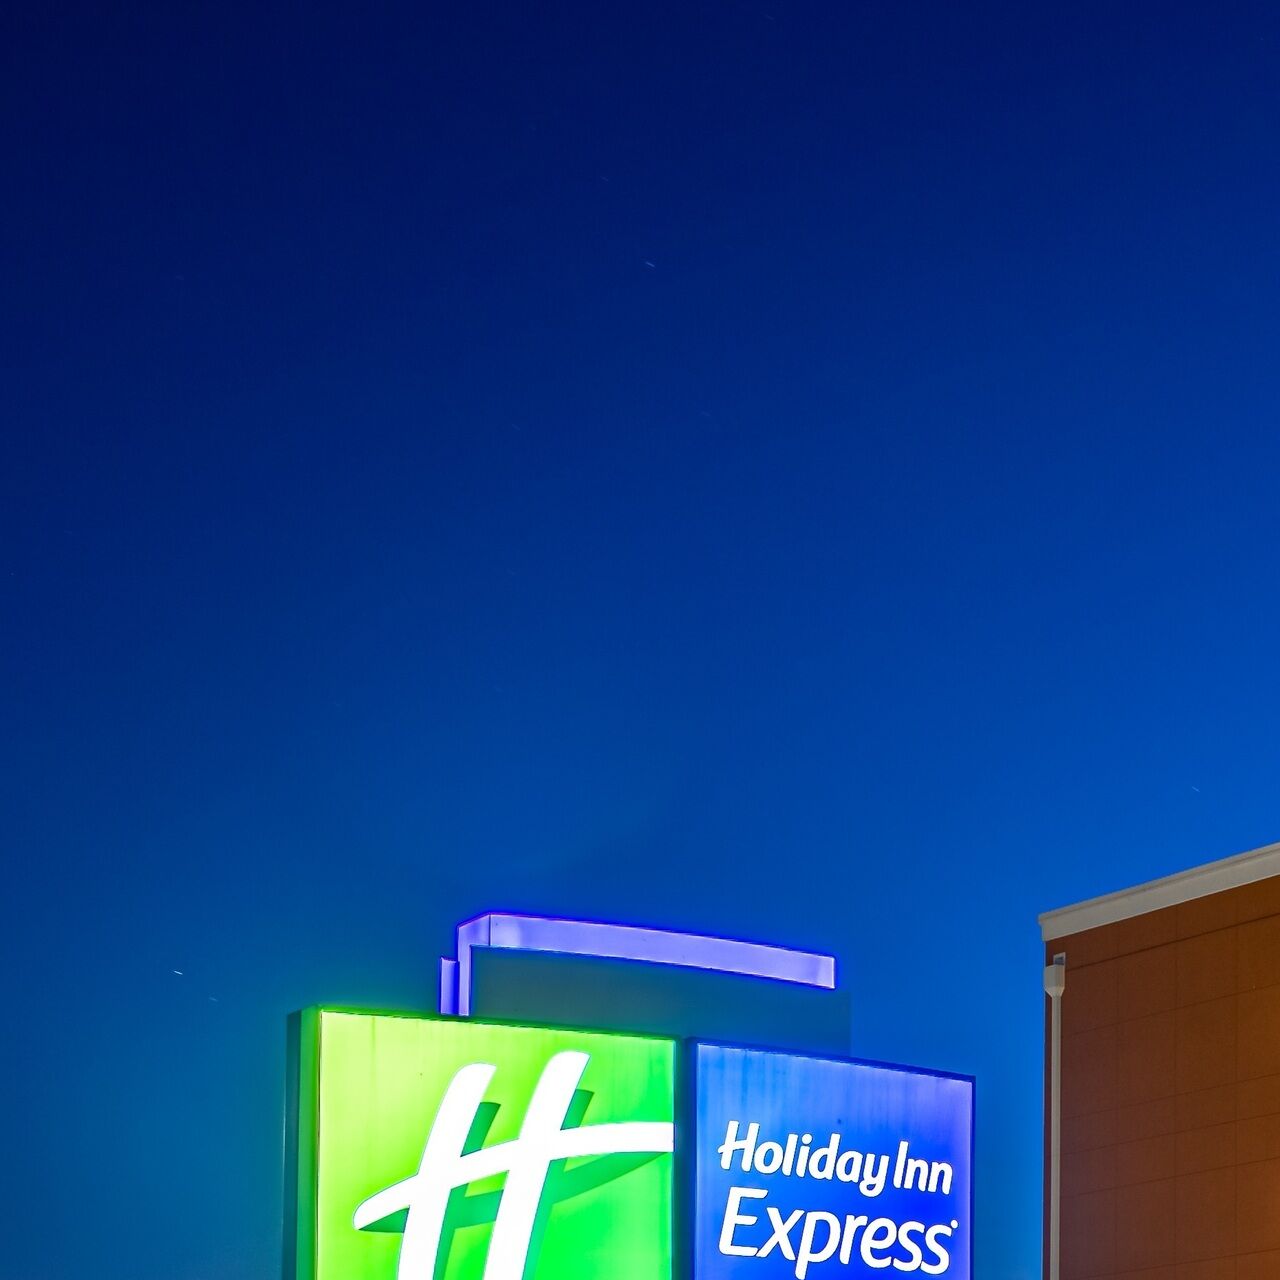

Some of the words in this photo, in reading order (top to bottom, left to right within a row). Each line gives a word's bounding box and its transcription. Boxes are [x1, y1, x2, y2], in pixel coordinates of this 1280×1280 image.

[718, 1120, 889, 1197] Holiday
[893, 1140, 953, 1195] Inn
[718, 1186, 955, 1280] Express
